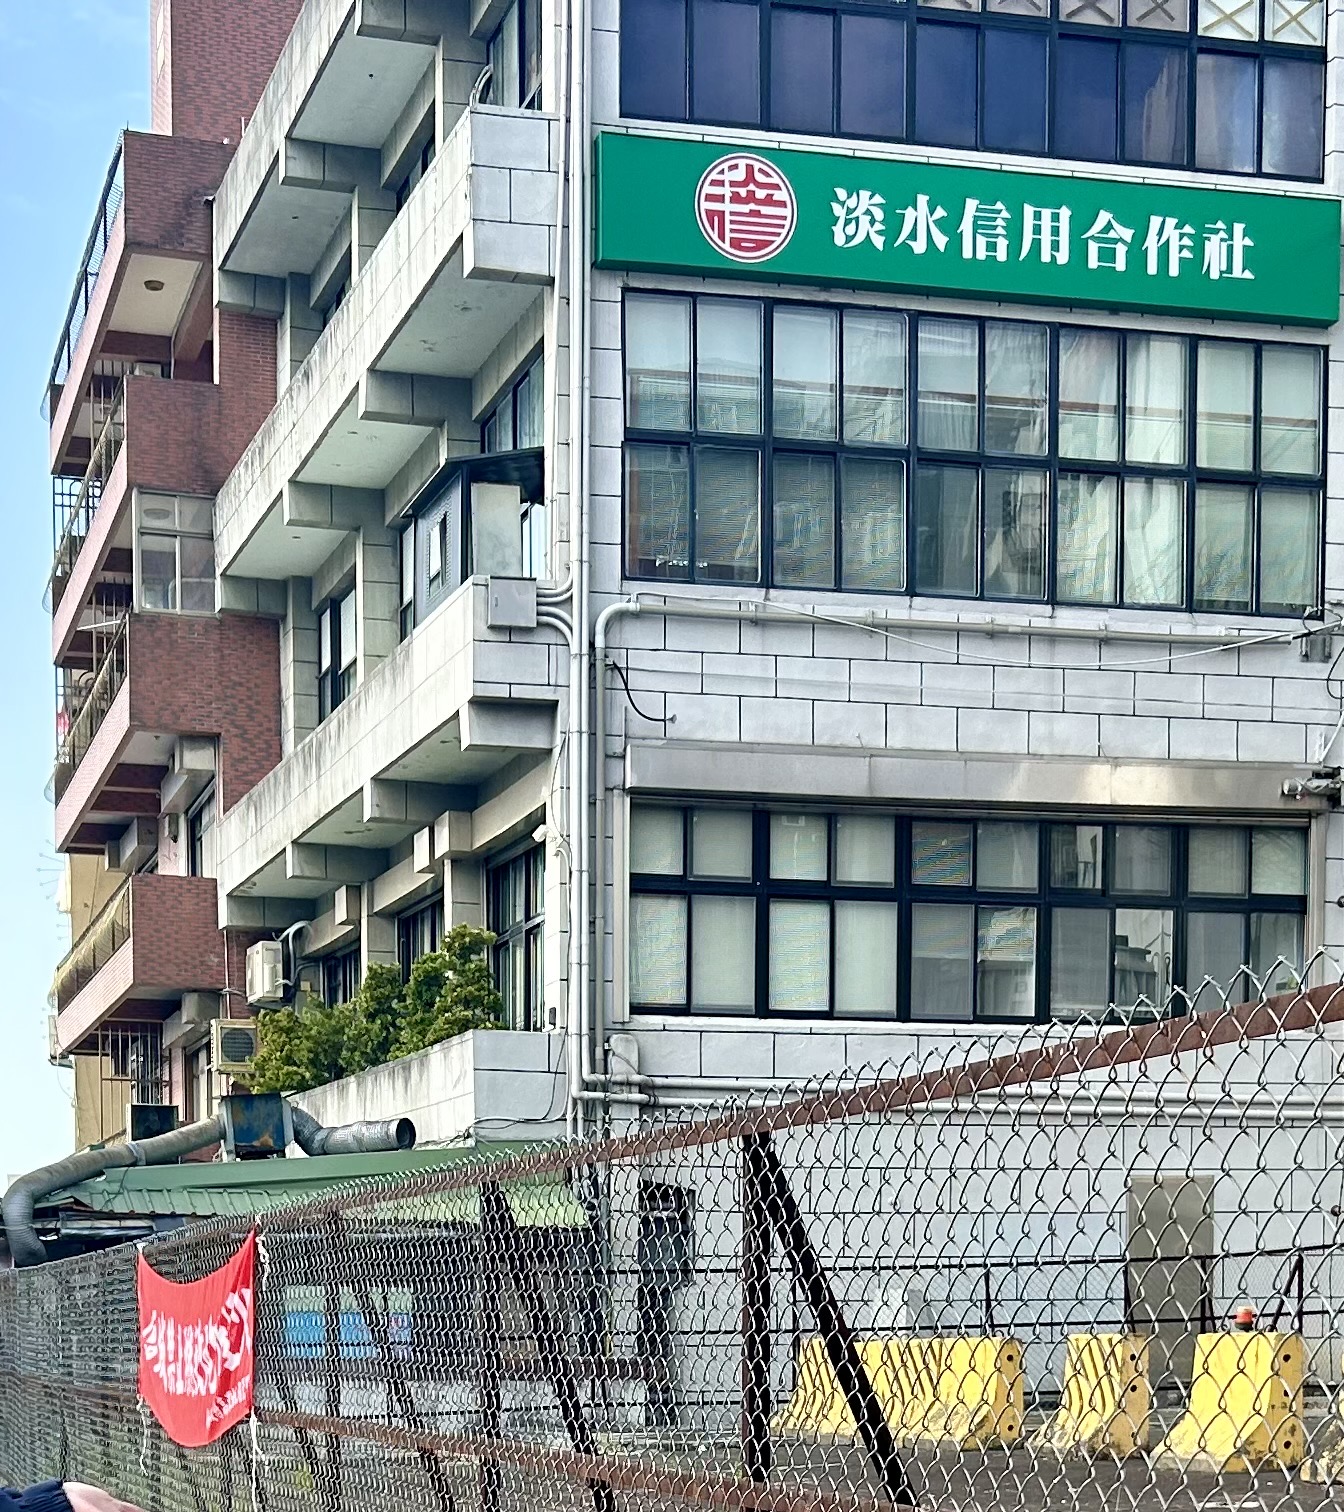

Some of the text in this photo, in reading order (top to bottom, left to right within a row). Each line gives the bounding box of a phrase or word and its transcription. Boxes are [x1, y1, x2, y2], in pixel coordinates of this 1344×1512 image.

[831, 187, 1256, 280] 淡水信用合作社
